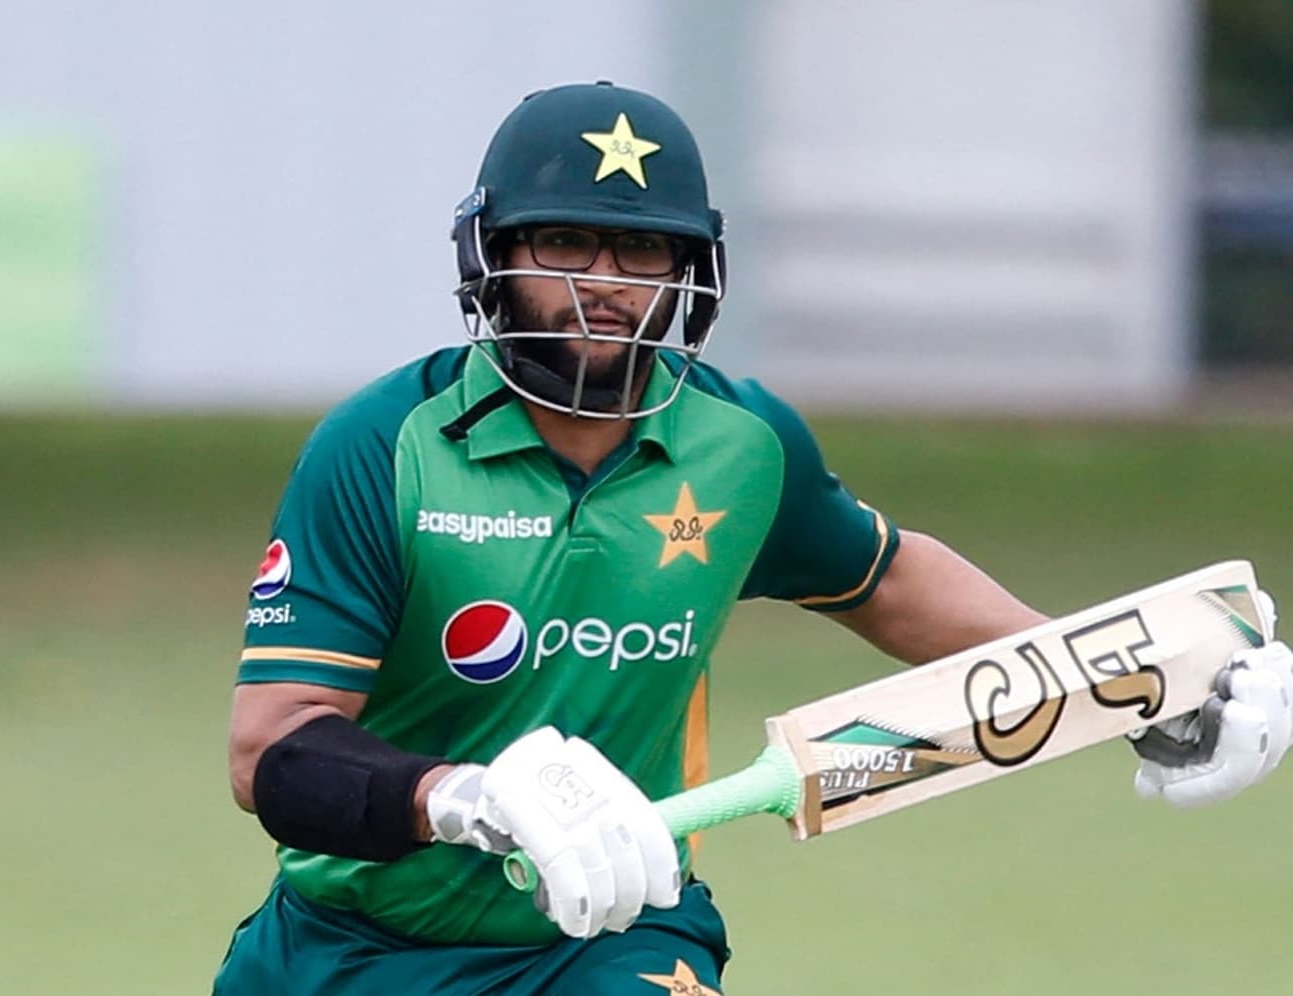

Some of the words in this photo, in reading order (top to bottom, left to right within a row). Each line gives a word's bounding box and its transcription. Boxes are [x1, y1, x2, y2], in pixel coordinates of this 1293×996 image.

[416, 509, 553, 544] easypaisa
[532, 609, 695, 671] pepsi
[832, 748, 916, 772] 15000
